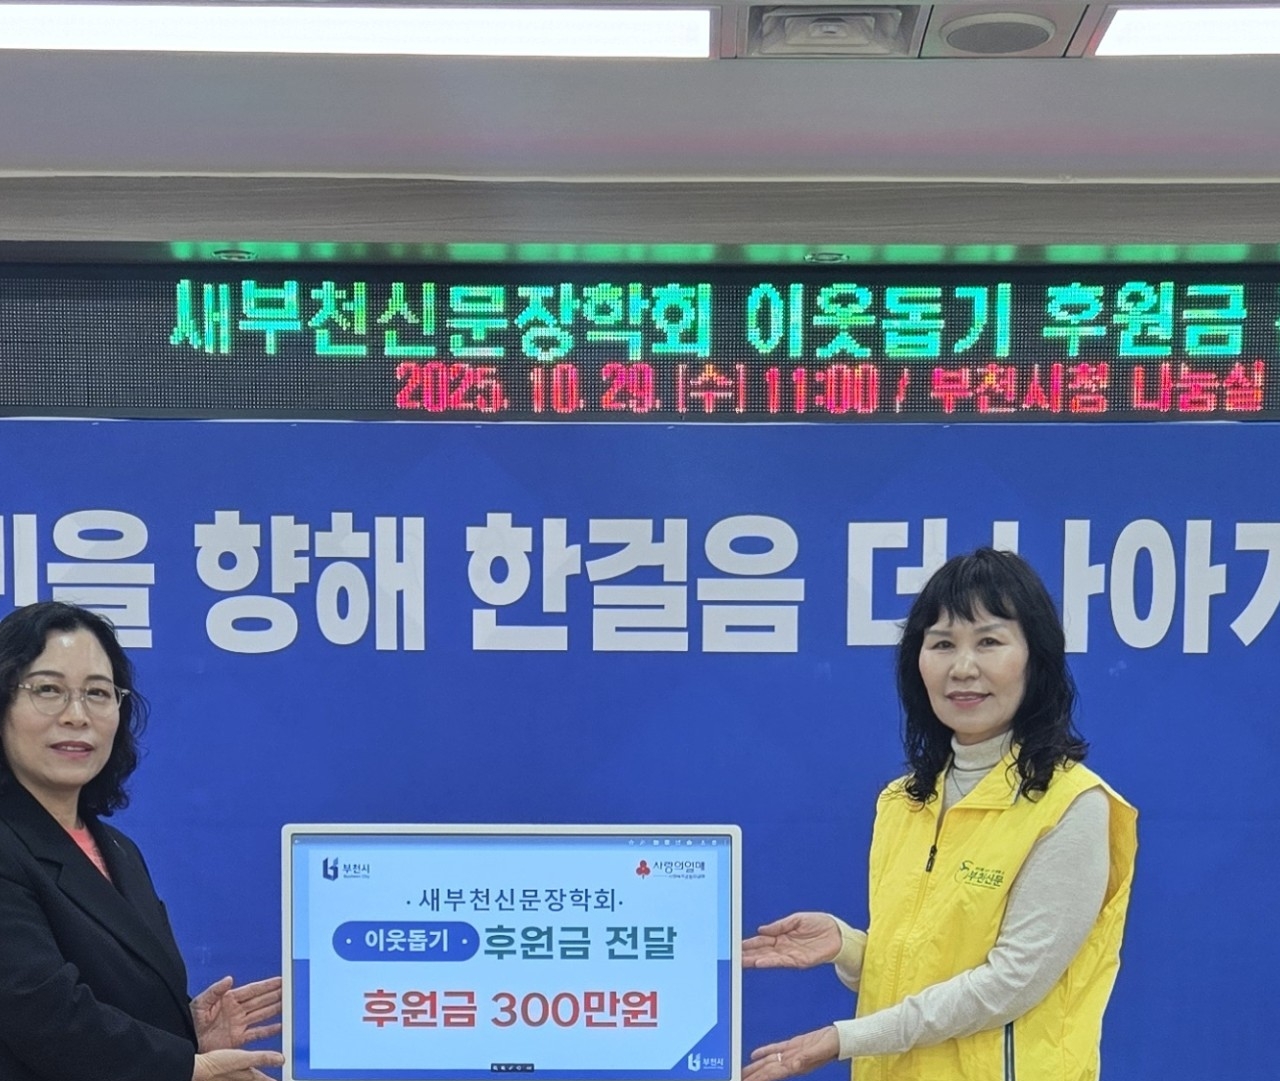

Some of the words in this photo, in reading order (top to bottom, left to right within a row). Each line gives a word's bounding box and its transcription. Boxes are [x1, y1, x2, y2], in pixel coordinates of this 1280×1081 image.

[169, 278, 713, 361] 새부천신문장학회
[745, 282, 1013, 358] 이웃돕기
[1042, 282, 1248, 358] 후원금
[396, 362, 509, 412] 2025.
[531, 363, 584, 413] 10.
[601, 362, 661, 413] 29.
[765, 364, 880, 413] 11:00
[896, 368, 909, 413] /
[931, 362, 1110, 413] 부천시청
[1133, 360, 1265, 412] 나눔실
[195, 511, 425, 653] 향해
[466, 512, 805, 652] 한걸음
[847, 517, 947, 646] 더
[419, 888, 615, 912] 새부천신문장학회
[365, 929, 448, 952] 이웃돕기
[484, 924, 591, 960] 후원금
[606, 926, 677, 960] 전달
[362, 989, 477, 1028] 후원금
[491, 991, 658, 1028] 300만원
